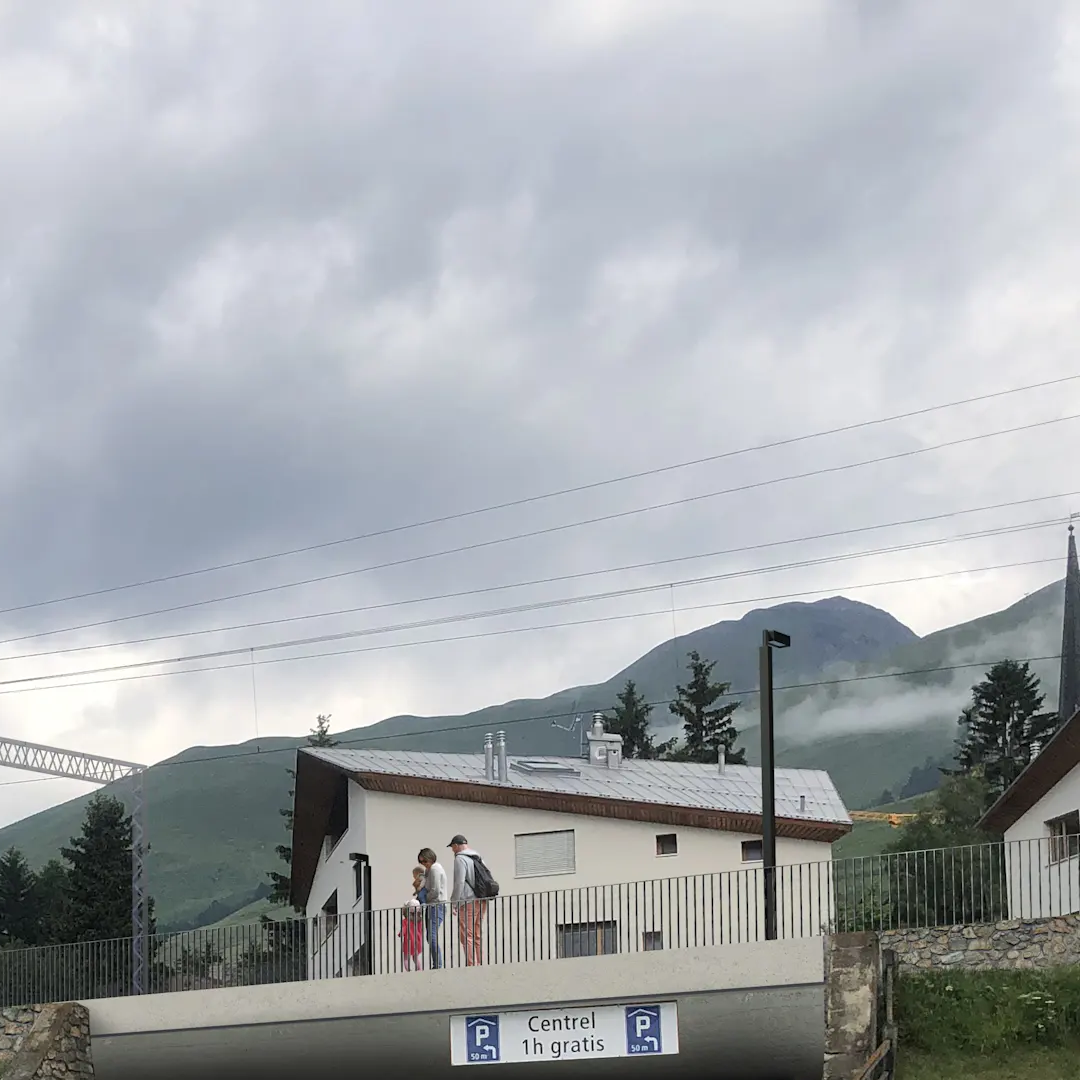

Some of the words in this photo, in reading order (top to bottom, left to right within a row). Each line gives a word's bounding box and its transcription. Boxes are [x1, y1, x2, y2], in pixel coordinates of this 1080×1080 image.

[528, 1012, 595, 1032] Centrel
[636, 1015, 650, 1037] P
[476, 1025, 489, 1046] P
[551, 1035, 605, 1058] gratis
[631, 1044, 640, 1052] 50
